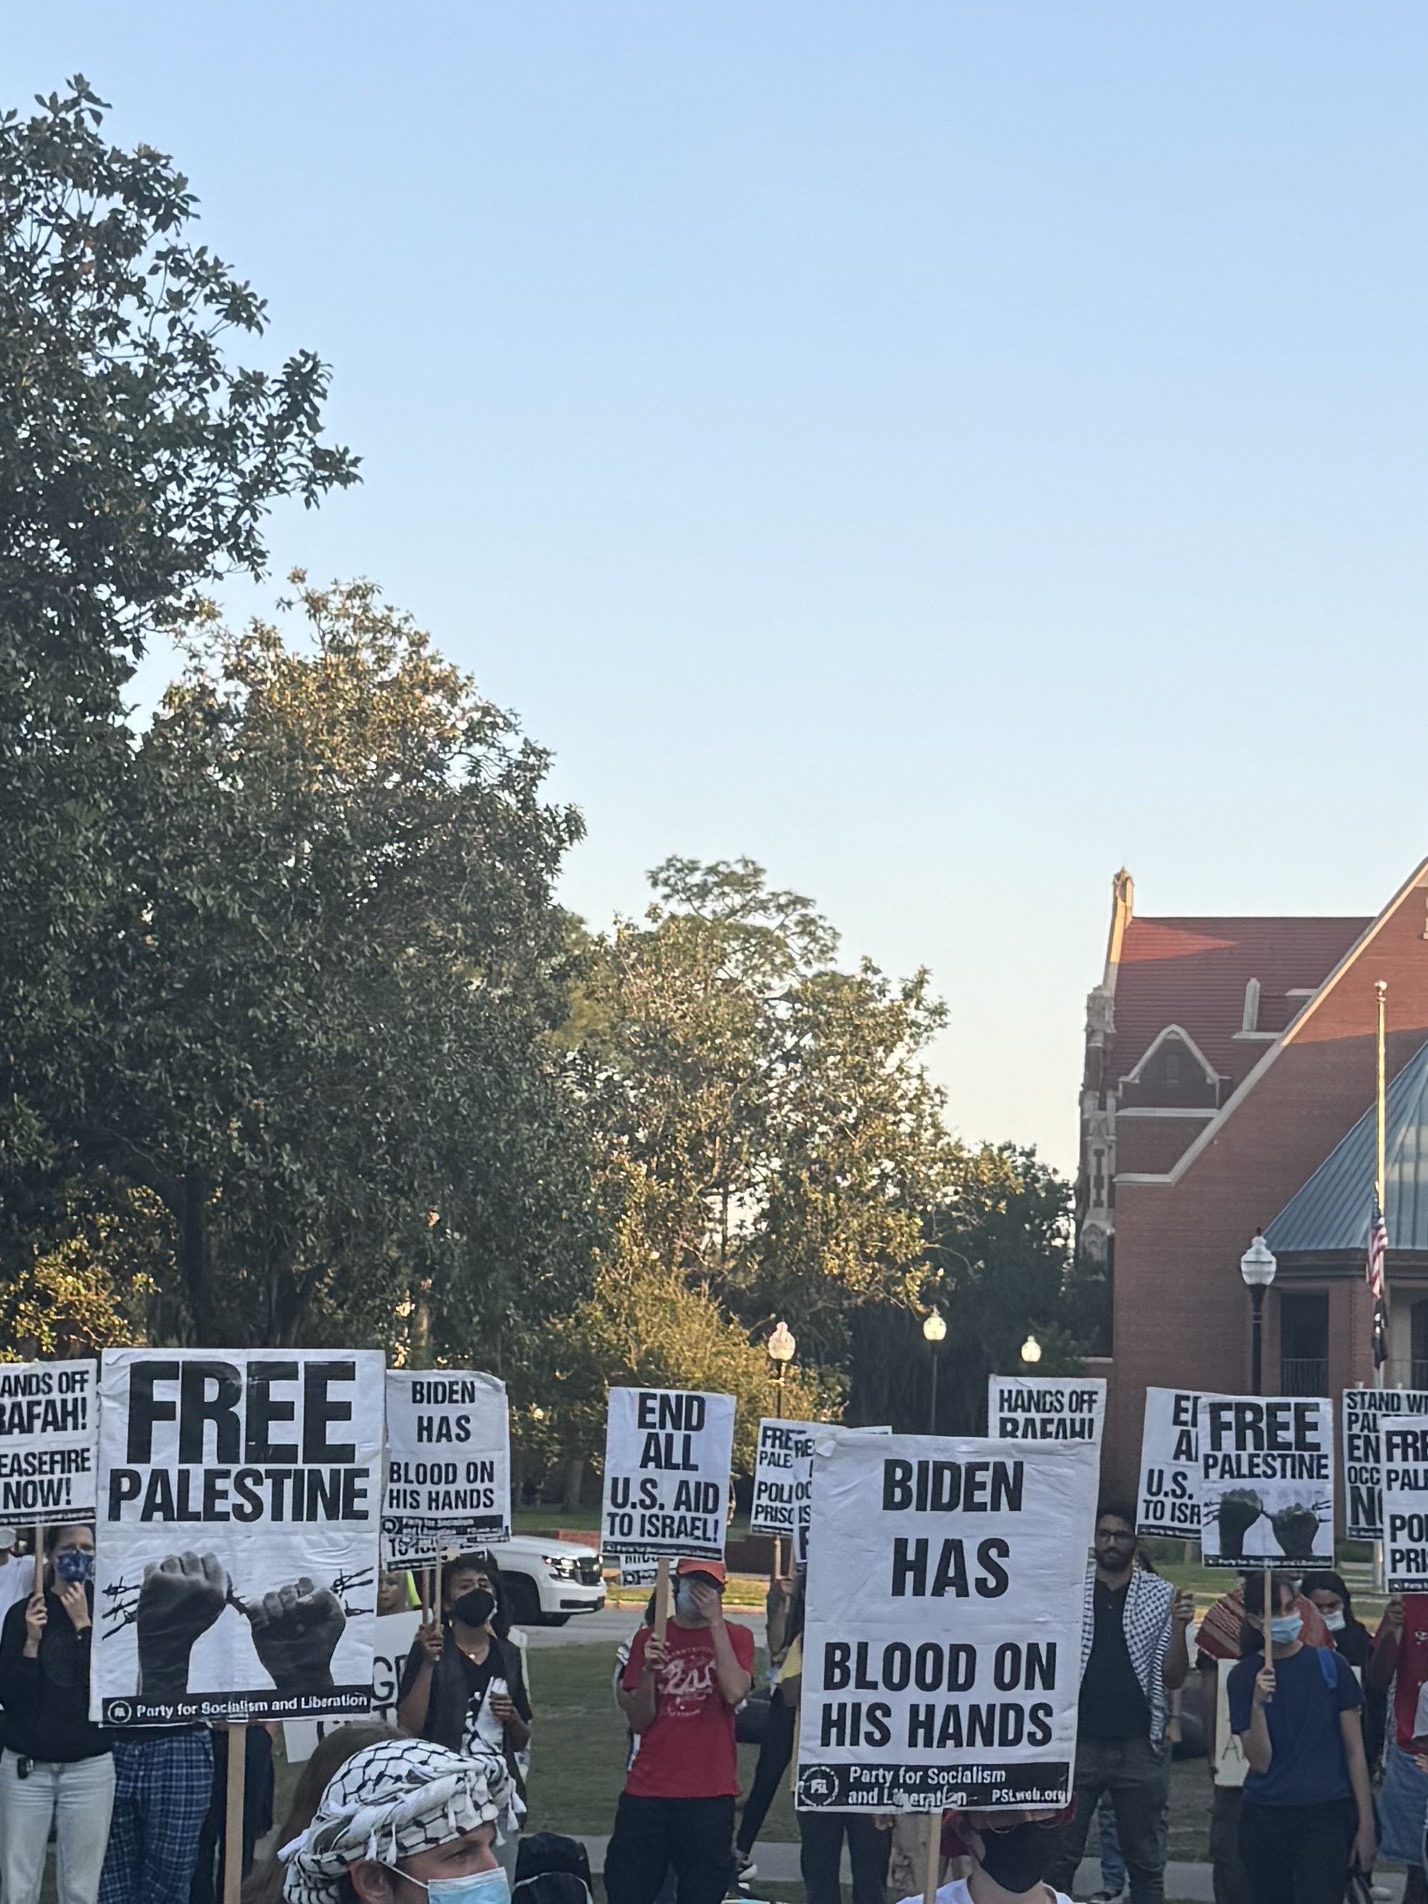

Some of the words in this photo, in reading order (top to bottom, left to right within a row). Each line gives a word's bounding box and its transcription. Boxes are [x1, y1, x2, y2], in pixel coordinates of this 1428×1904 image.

[58, 1370, 89, 1394] OFF
[412, 1381, 475, 1404] BIDEN
[126, 1361, 355, 1464] FREE
[638, 1392, 706, 1431] END
[999, 1389, 1064, 1413] HANDS
[1068, 1389, 1098, 1413] OFF
[1346, 1391, 1400, 1412] STAND
[417, 1415, 471, 1443] HAS
[1209, 1402, 1321, 1452] FREE
[639, 1432, 699, 1471] ALL
[1347, 1434, 1380, 1463] EN
[389, 1461, 457, 1485] BLOOD
[466, 1461, 494, 1483] ON
[1203, 1453, 1329, 1480] PALESTINE
[3, 1478, 71, 1510] NOW!
[107, 1468, 369, 1522] PALESTINE
[610, 1477, 665, 1511] U.S.
[673, 1480, 719, 1514] AID
[882, 1459, 1024, 1512] BIDEN
[1147, 1469, 1194, 1500] U.S.
[389, 1489, 420, 1509] HIS
[428, 1489, 494, 1511] HANDS
[1143, 1500, 1165, 1521] TO
[607, 1512, 633, 1537] TO
[640, 1514, 719, 1542] ISRAEL!
[891, 1537, 1010, 1598] HAS
[823, 1642, 977, 1692] BLOOD
[994, 1642, 1057, 1692] ON
[136, 1703, 172, 1719] Party
[177, 1702, 198, 1717] for
[202, 1700, 268, 1715] Socialism
[272, 1697, 298, 1711] and
[301, 1694, 367, 1710] Liberation
[820, 1702, 891, 1747] HIS
[908, 1703, 1053, 1749] HANDS
[849, 1766, 893, 1786] Party
[899, 1766, 922, 1784] for
[927, 1766, 1006, 1784] Socialism
[848, 1789, 878, 1805] and
